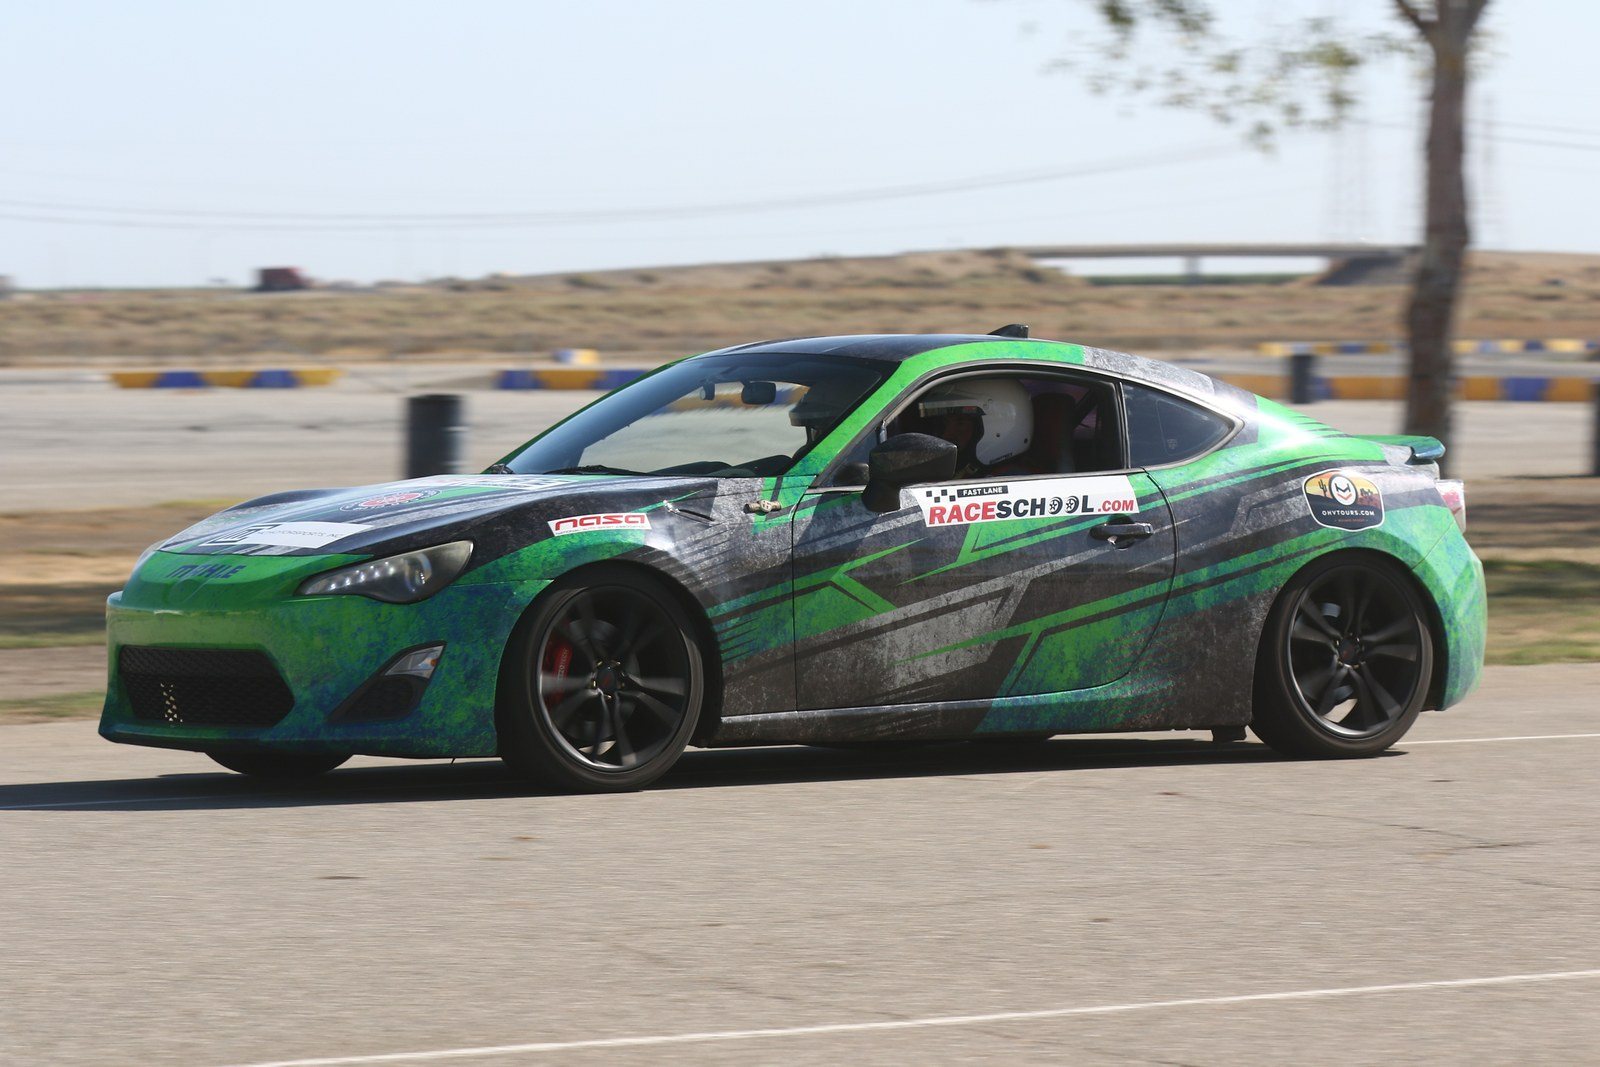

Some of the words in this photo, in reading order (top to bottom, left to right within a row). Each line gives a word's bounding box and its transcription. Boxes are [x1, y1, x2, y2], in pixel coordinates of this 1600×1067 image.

[962, 487, 983, 496] FAST
[983, 486, 1003, 494] LANE
[166, 564, 247, 579] MAHLE
